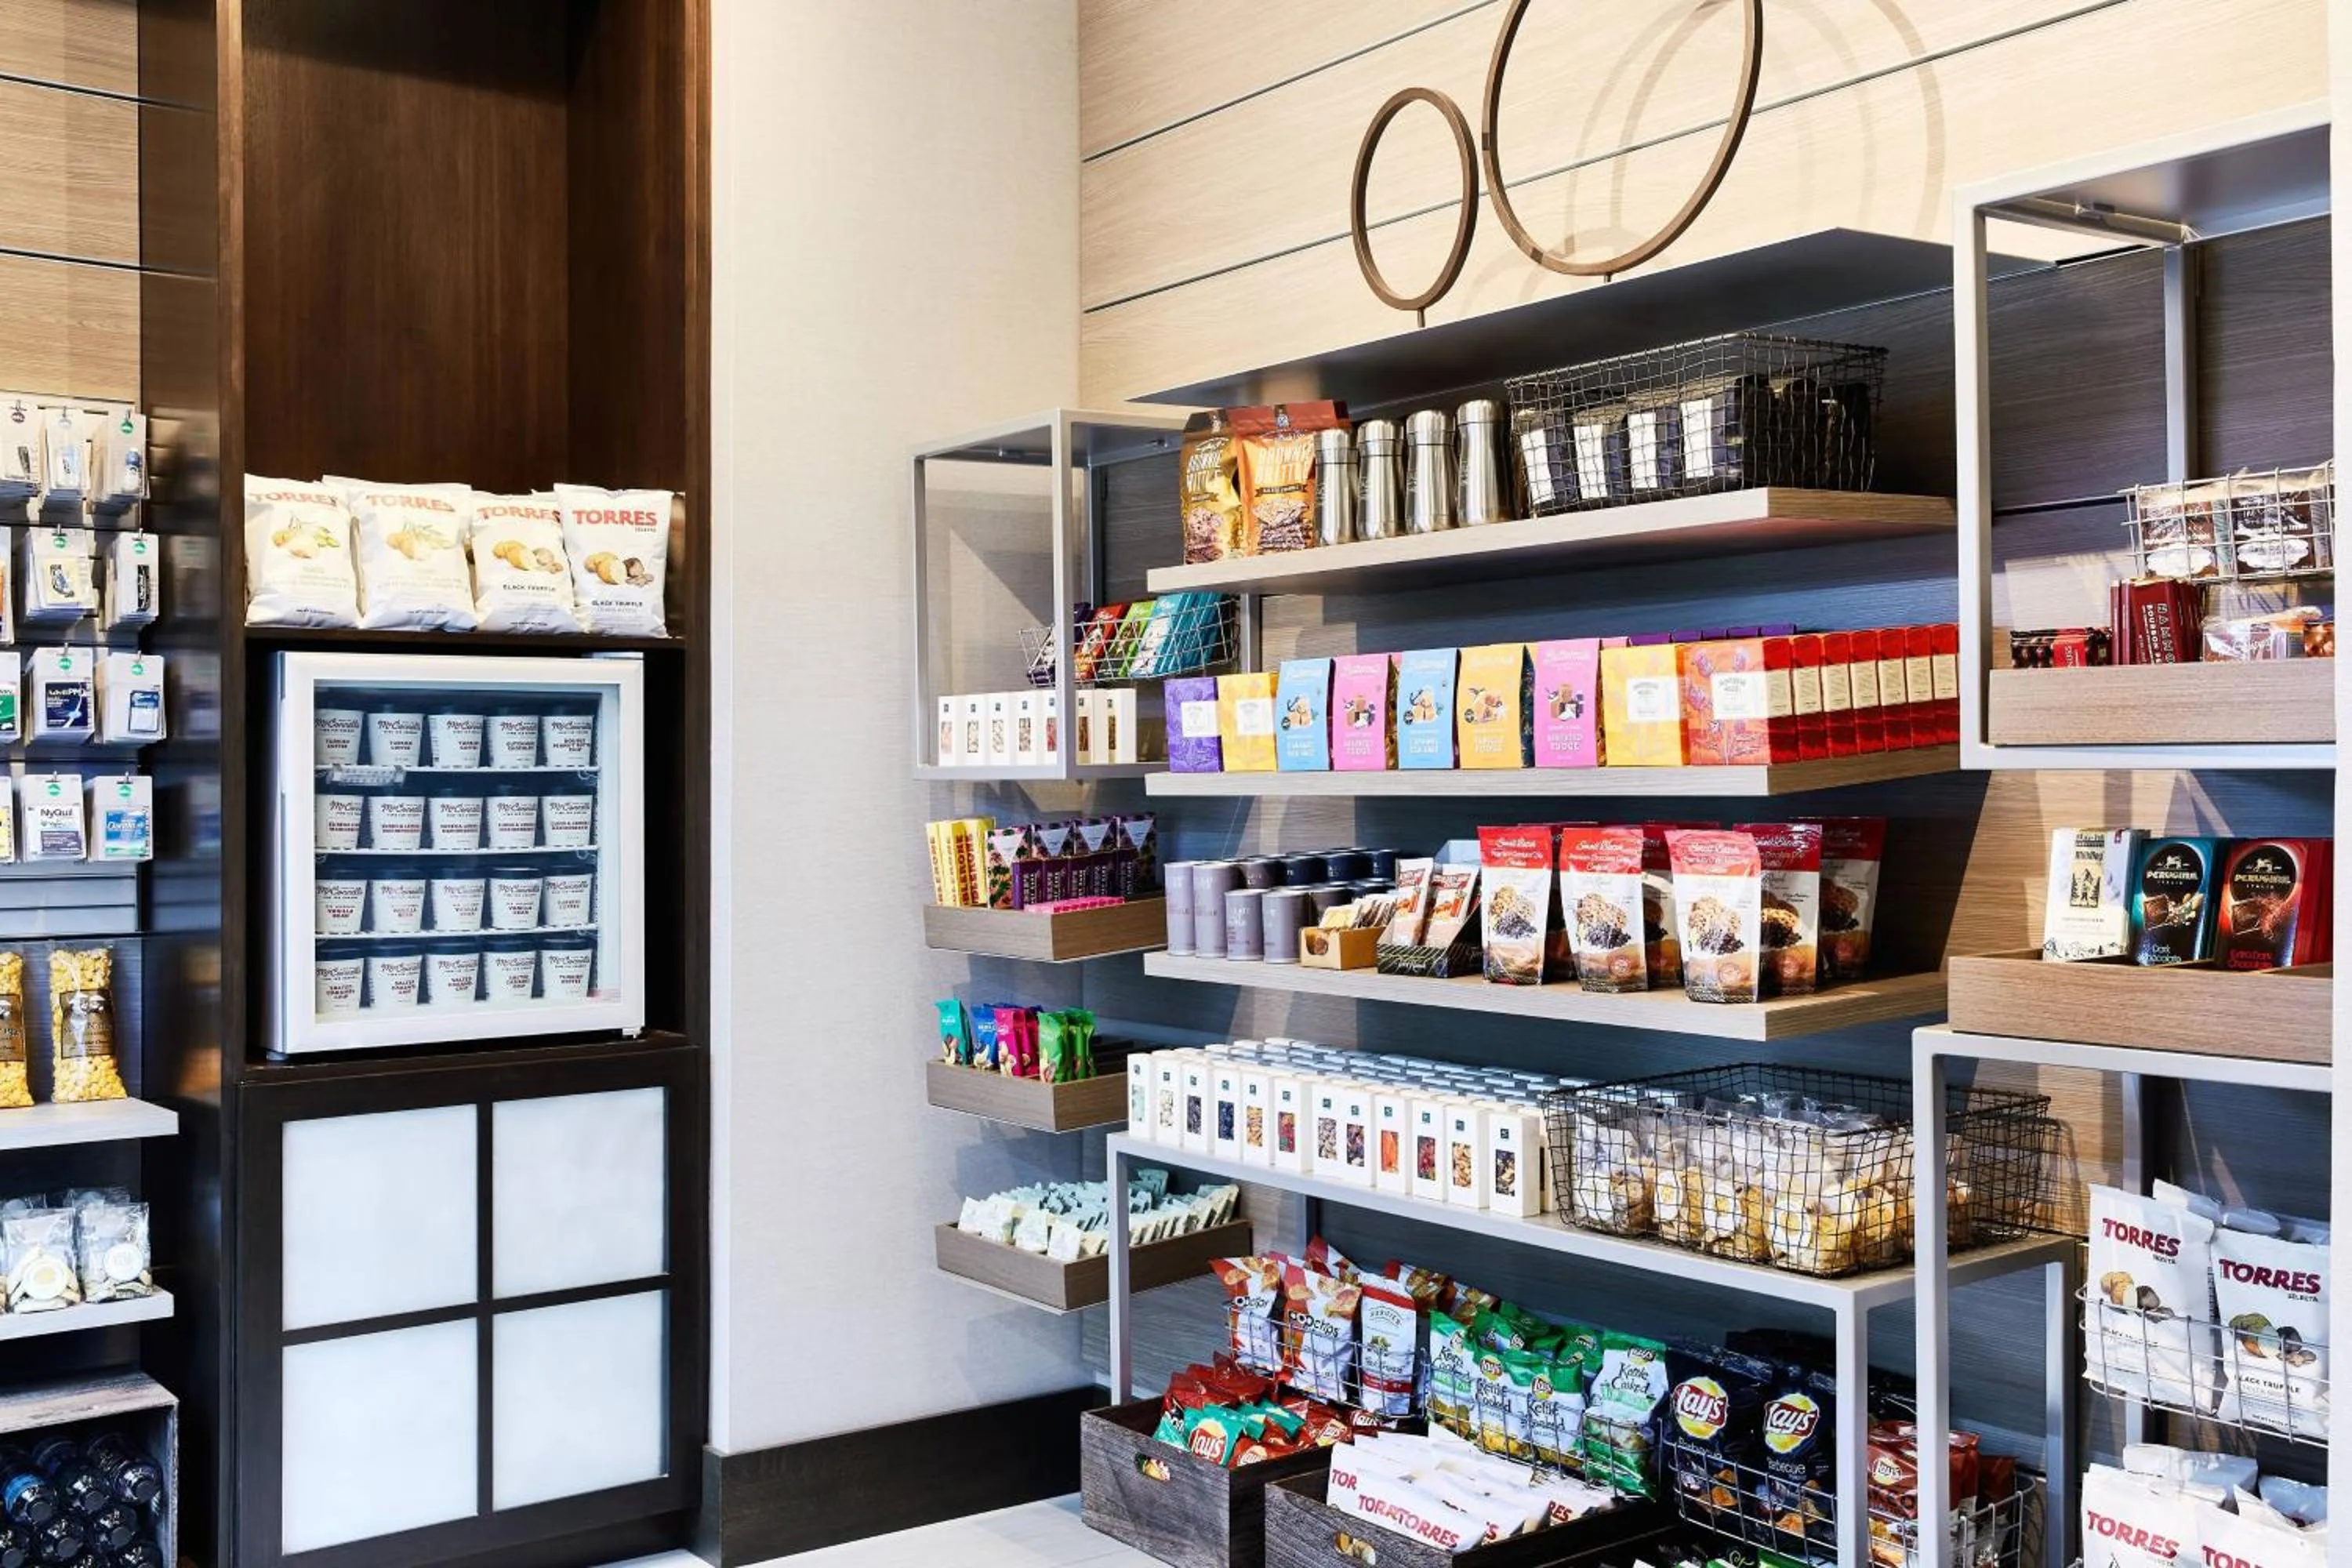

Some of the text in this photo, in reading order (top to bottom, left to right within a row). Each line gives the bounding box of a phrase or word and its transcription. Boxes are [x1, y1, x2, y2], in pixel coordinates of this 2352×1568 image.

[477, 506, 561, 524] TORRES
[572, 510, 658, 526] TORRES
[2102, 1218, 2181, 1258] TORRES
[2218, 1259, 2321, 1294] TORRES
[2263, 1380, 2301, 1393] TRUFLE
[1331, 1469, 1357, 1490] TOR
[1548, 1500, 1574, 1523] RES
[2087, 1509, 2180, 1559] TORRES
